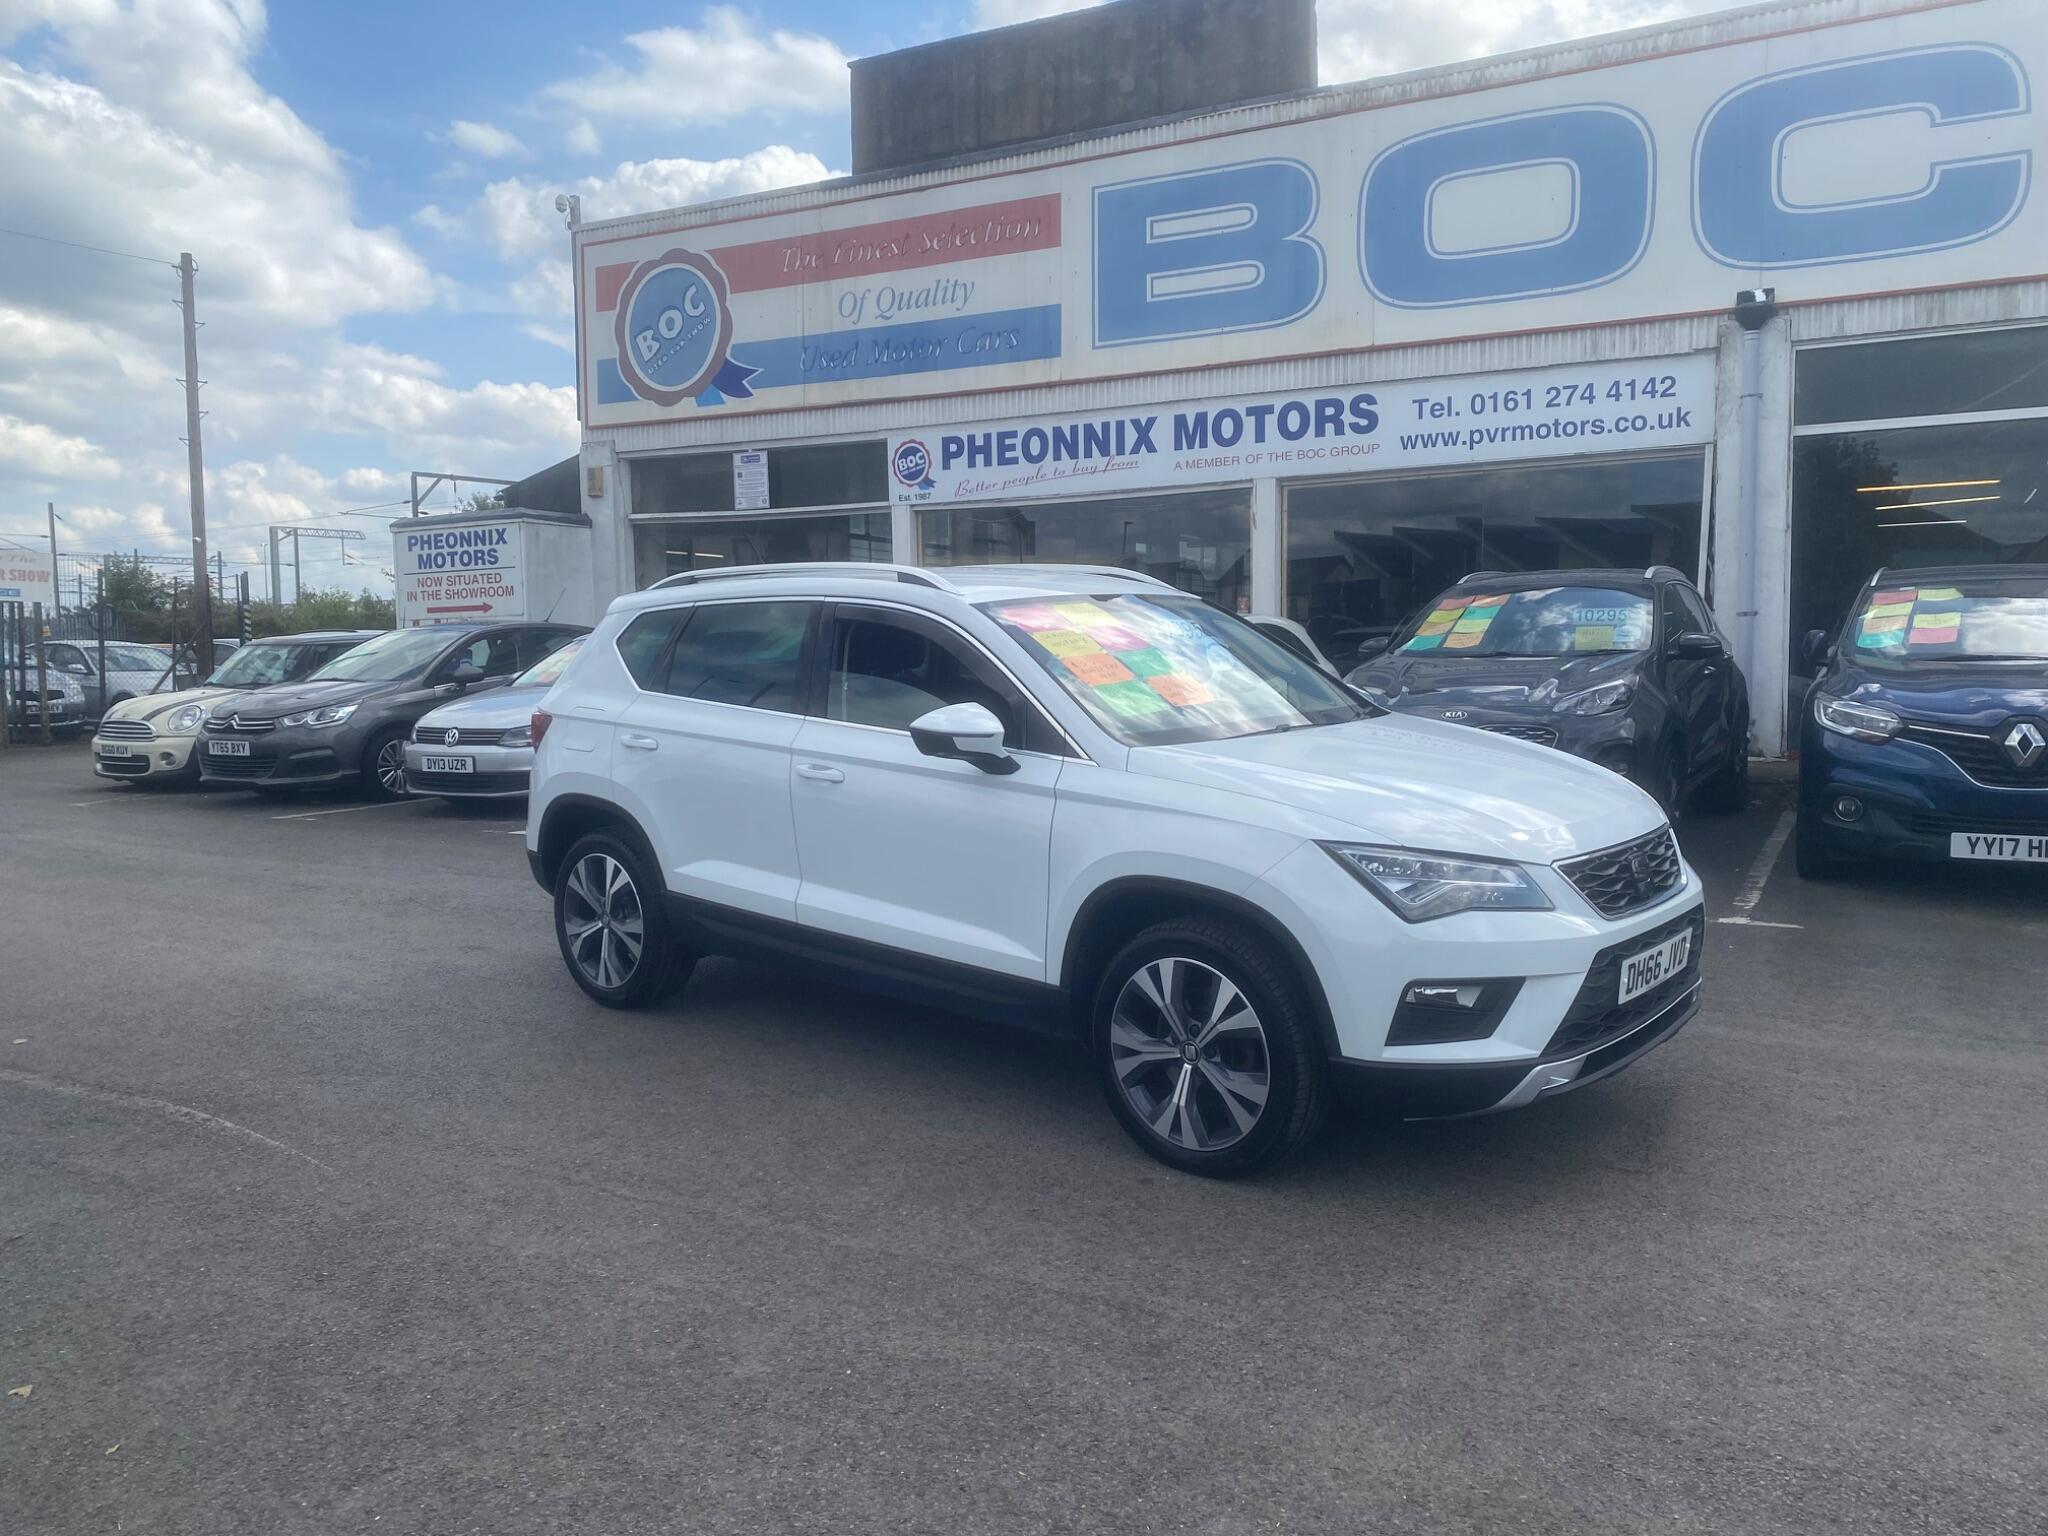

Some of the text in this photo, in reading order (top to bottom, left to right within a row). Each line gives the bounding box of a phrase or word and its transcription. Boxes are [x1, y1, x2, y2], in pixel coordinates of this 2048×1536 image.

[1092, 42, 2031, 350] BOC
[781, 215, 1041, 273] The Finest Selection
[635, 283, 707, 363] BOC
[838, 278, 975, 325] Of Quality
[799, 325, 1020, 372] Used Motor Cars
[1412, 375, 1677, 420] Tel. 0161 274 4142
[941, 393, 1379, 470] PHEONNIX MOTORS
[1400, 406, 1692, 451] www.pvrmotors.co.uk
[897, 452, 926, 471] BOC
[954, 454, 1140, 498] Better people to buy from
[1174, 443, 1381, 471] A MEMBER OF THE BOC GROUP
[407, 528, 508, 552] PHEONNIX
[417, 548, 500, 570] MOTORS
[407, 585, 515, 602] IN THE SHOWROOM
[417, 573, 502, 588] NOW SITUATED
[1575, 609, 1628, 622] 10295
[427, 757, 468, 771] DY13 UZR
[1966, 836, 2021, 857] YY17
[1625, 949, 1663, 995] DH66
